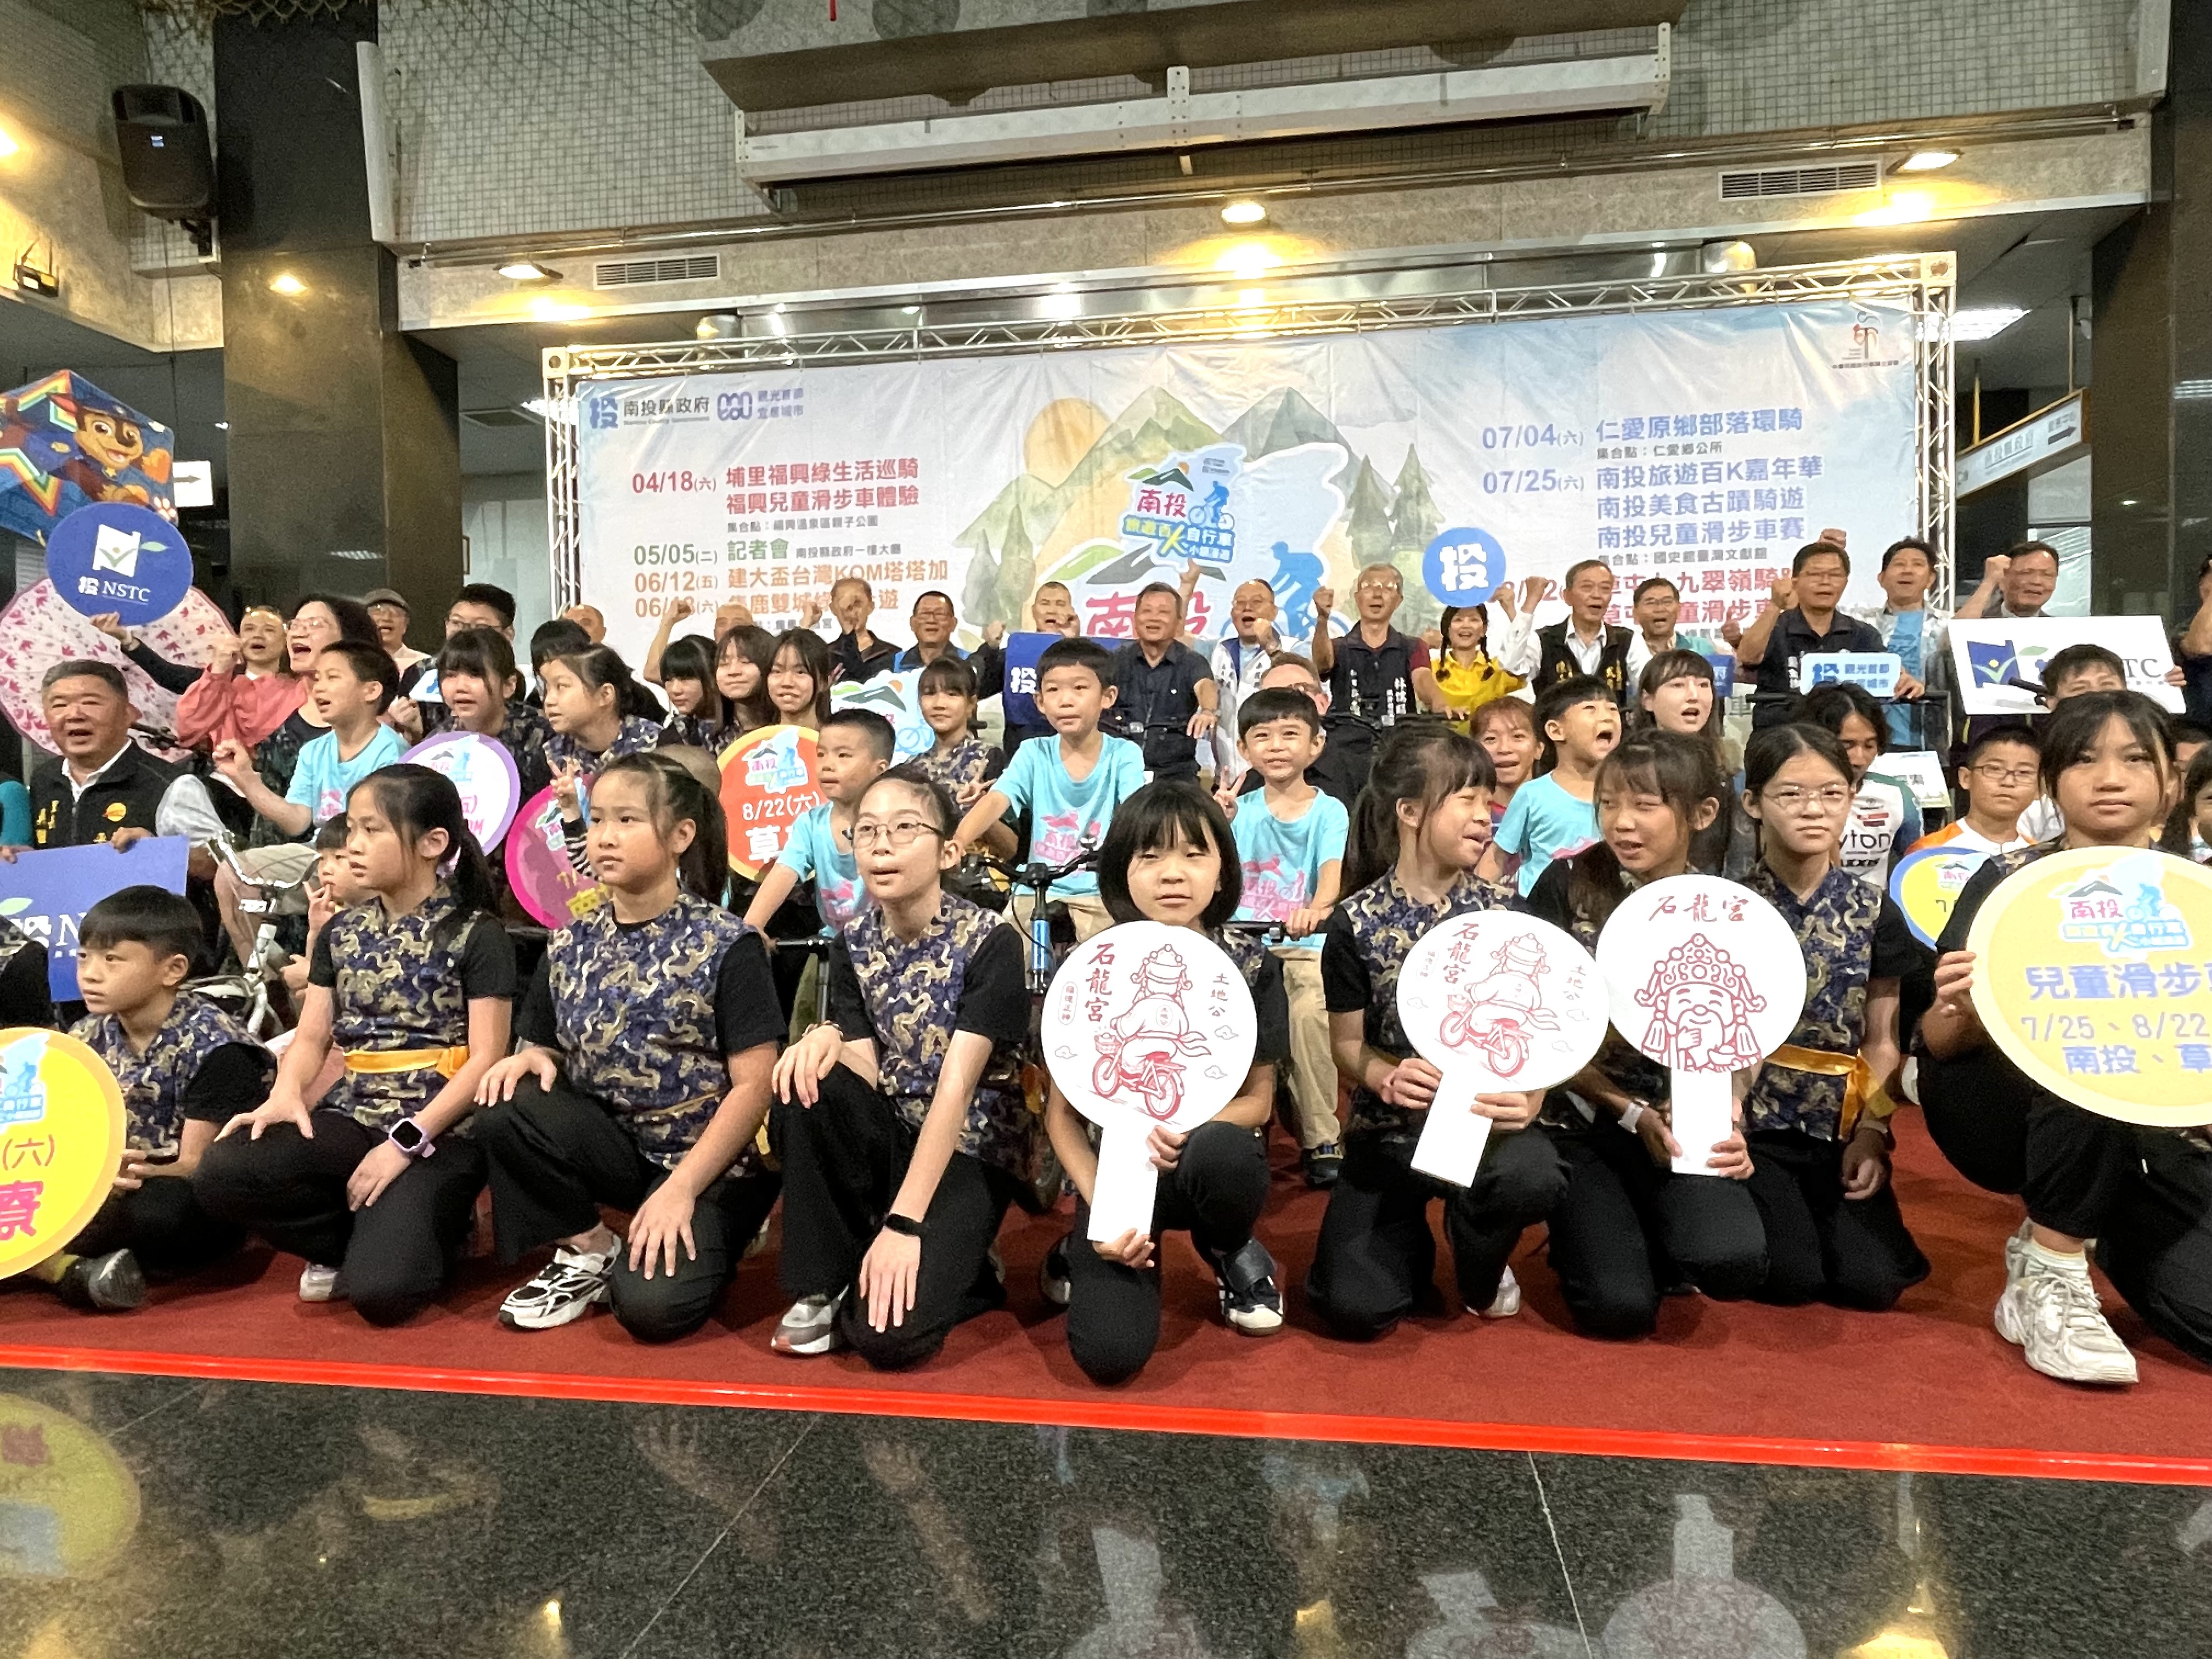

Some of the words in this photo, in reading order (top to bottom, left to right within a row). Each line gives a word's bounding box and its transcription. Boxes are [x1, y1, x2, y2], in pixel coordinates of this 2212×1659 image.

[1595, 407, 1803, 443] 仁愛原鄉部落環騎
[726, 458, 919, 488] 埔里福興綠生活巡騎
[1596, 455, 1822, 490] 南投旅遊百K嘉年華
[726, 484, 919, 515] 福興兒童滑步車體驗
[1137, 488, 1187, 518] 南投
[1596, 486, 1805, 520] 南投美食古蹟騎遊
[1597, 516, 1805, 549] 南投兒童滑步車賽
[727, 538, 790, 561] 記者會
[743, 790, 821, 821] 8/22(六)
[1647, 893, 1750, 924] 石龍宮
[1085, 943, 1116, 1023] 石龍宮
[1208, 973, 1229, 1017] 土地公
[2025, 961, 2212, 1001] 兒童滑步
